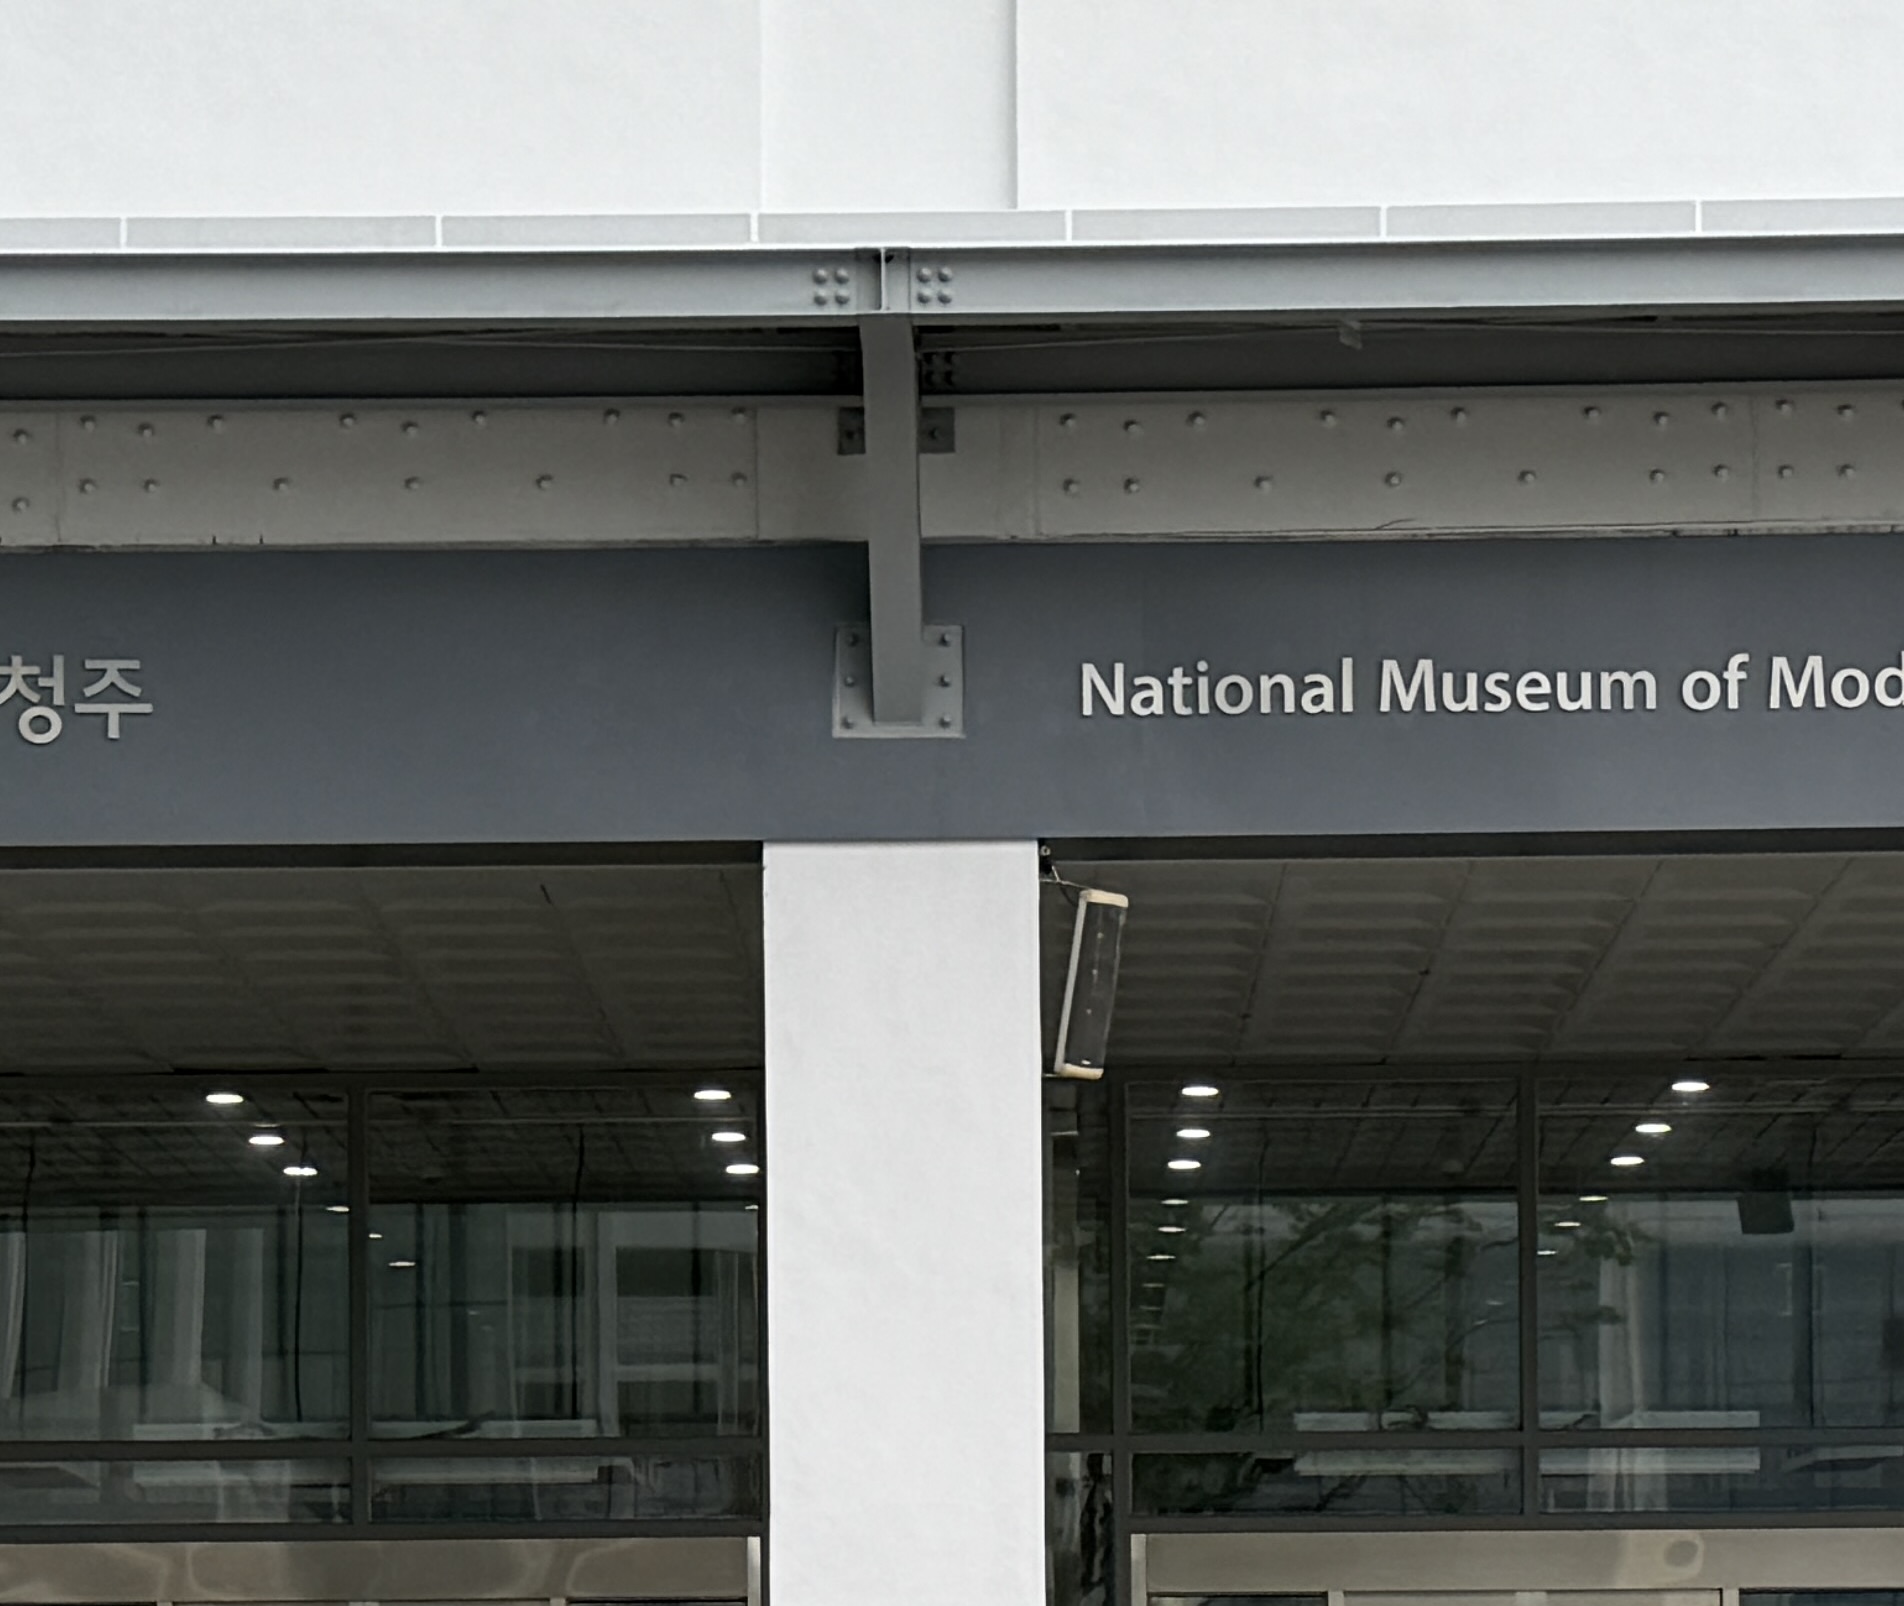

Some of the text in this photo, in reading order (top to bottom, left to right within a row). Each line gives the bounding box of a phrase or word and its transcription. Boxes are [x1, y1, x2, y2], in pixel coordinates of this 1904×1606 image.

[1080, 657, 1354, 717] National
[1380, 656, 1658, 713] Museum
[1682, 653, 1750, 711] of
